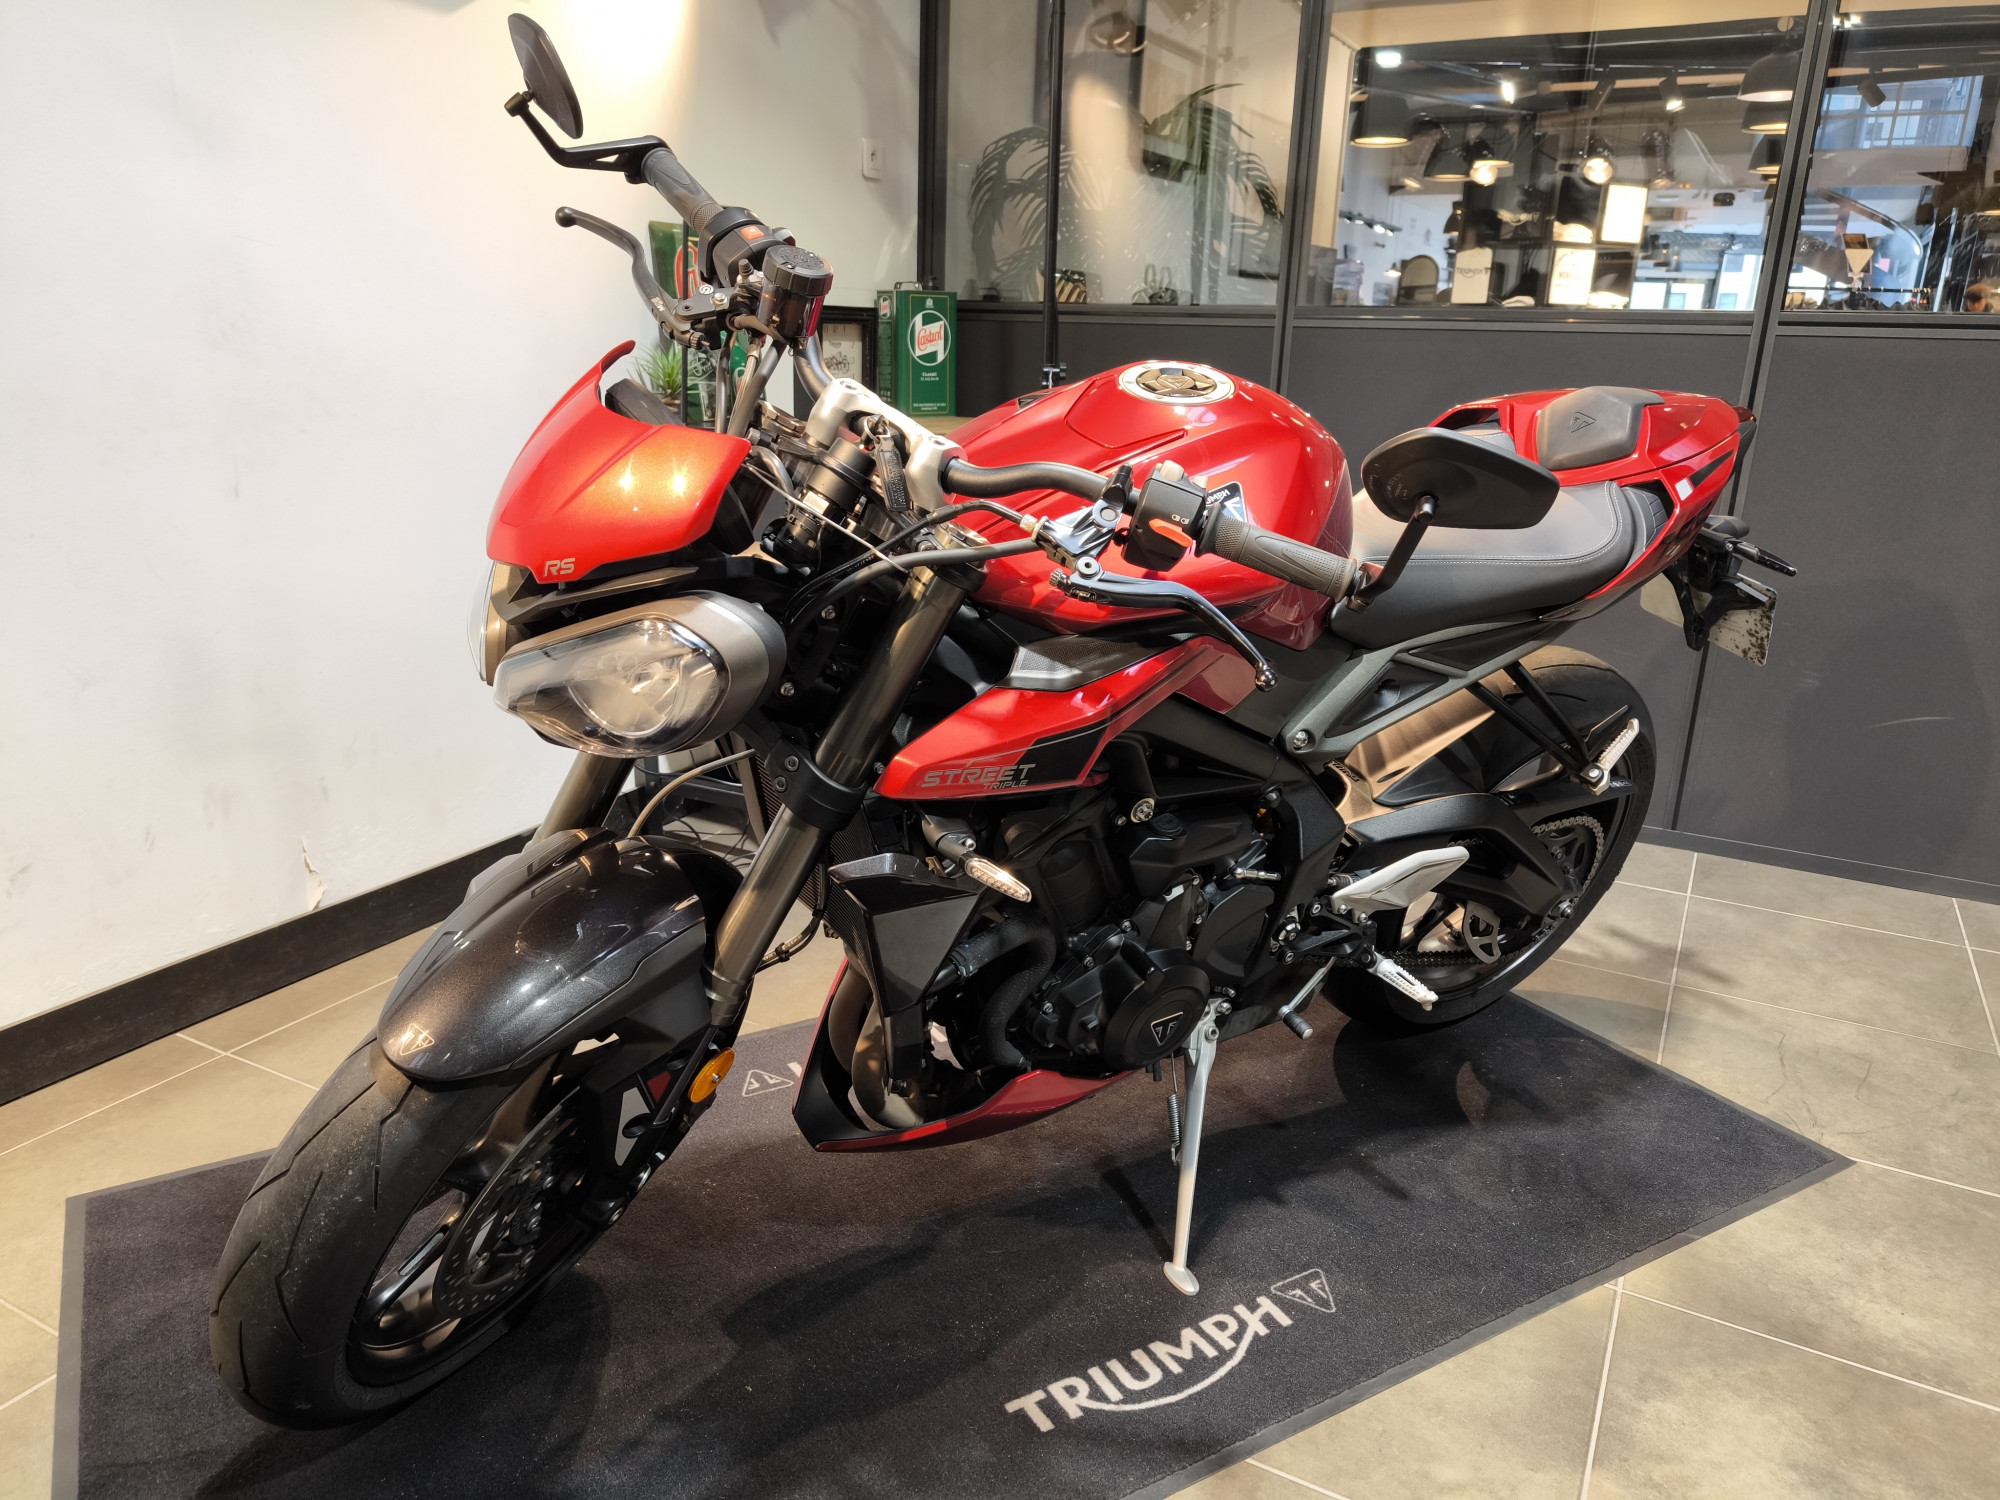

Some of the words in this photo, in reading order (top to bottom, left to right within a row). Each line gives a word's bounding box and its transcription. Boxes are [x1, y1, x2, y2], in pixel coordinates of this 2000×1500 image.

[917, 323, 944, 352] Castrol
[1205, 489, 1230, 506] UMPH
[544, 557, 576, 577] RS
[921, 763, 1036, 788] STREET
[983, 779, 1028, 790] TRIPLE
[1004, 1296, 1294, 1432] TRIUMPH
